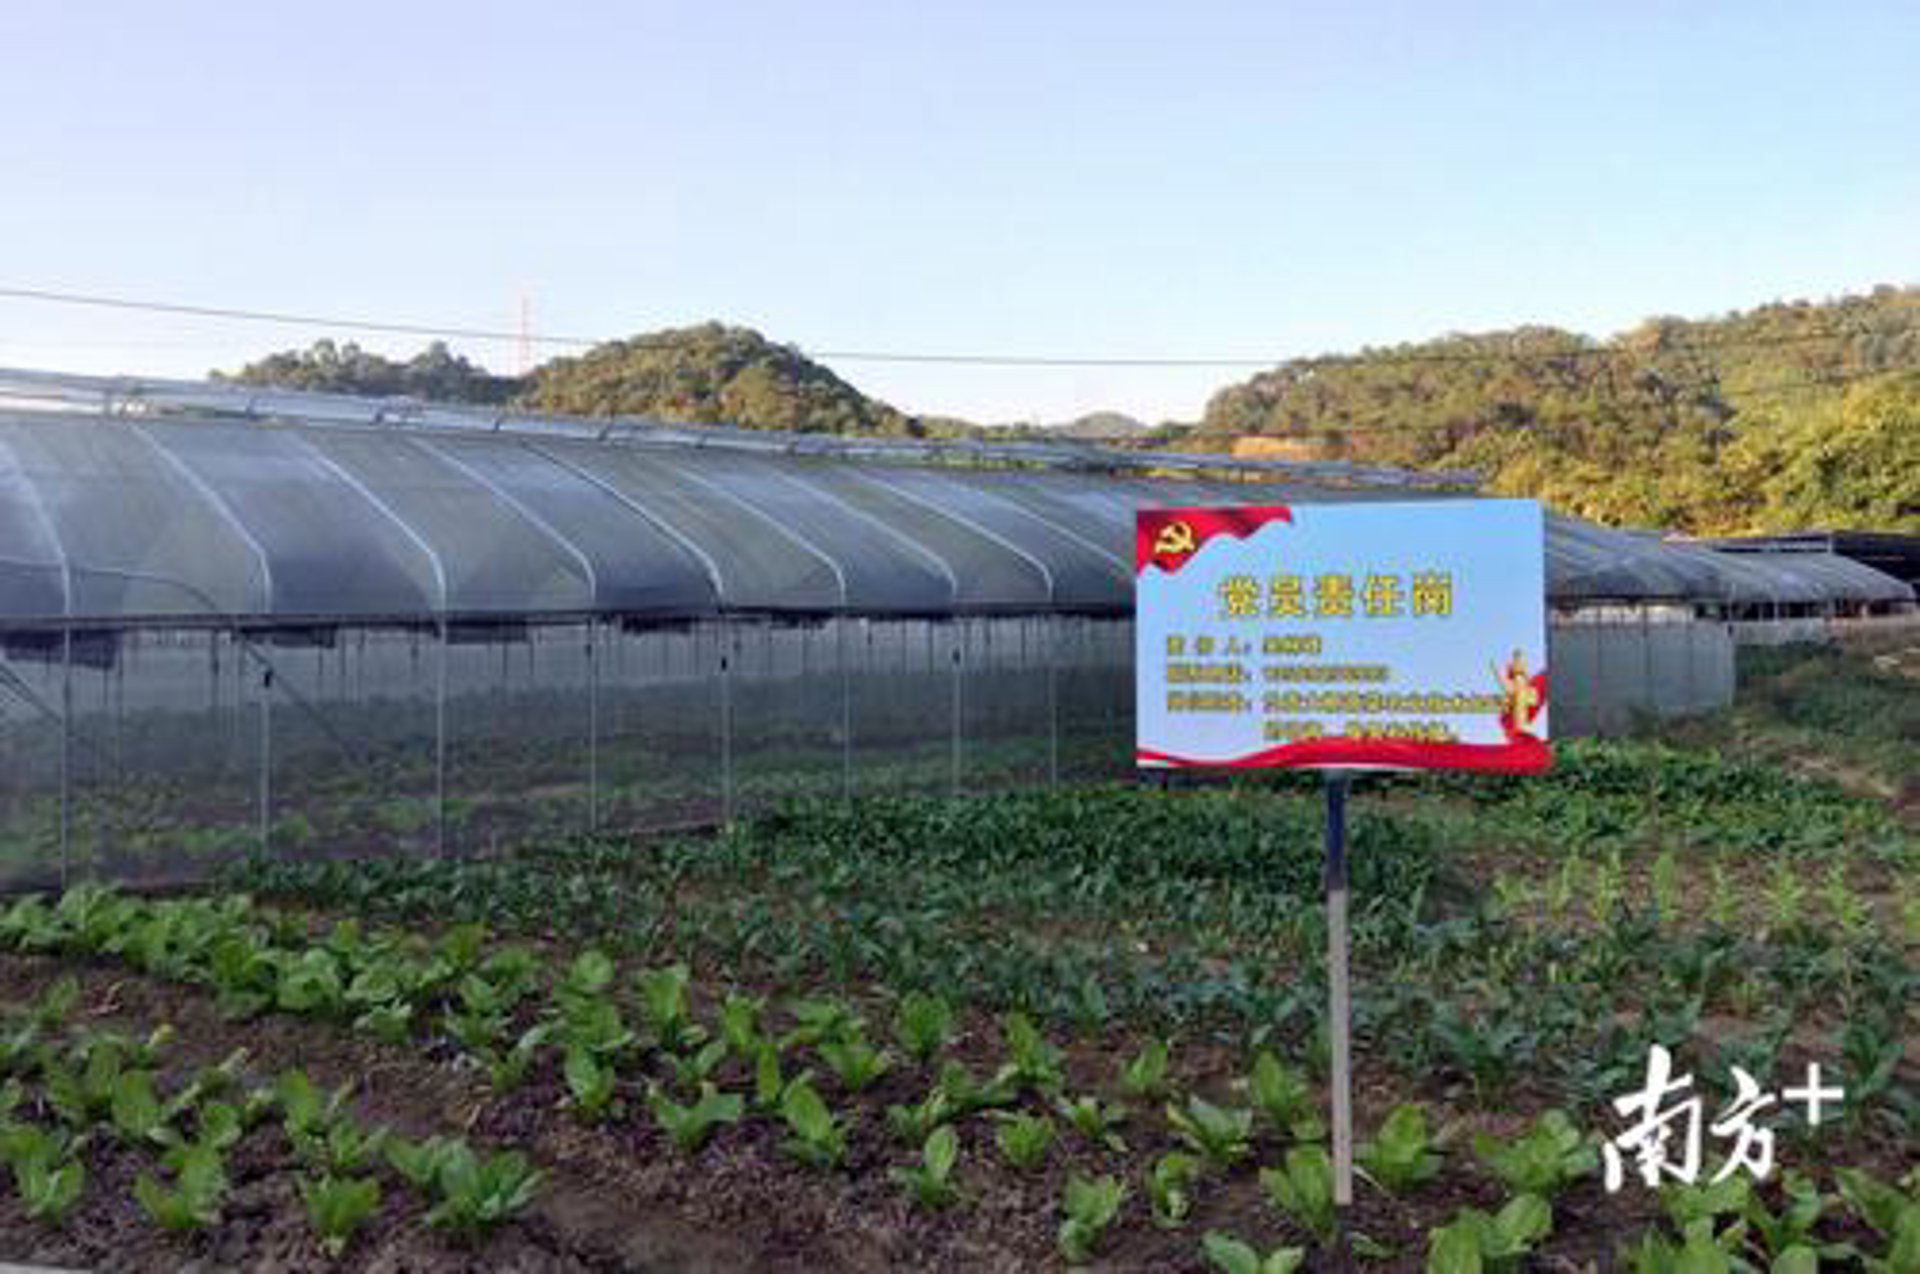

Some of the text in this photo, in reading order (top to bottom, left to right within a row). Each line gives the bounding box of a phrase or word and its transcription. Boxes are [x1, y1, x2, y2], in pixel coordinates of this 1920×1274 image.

[1217, 574, 1453, 617] 党员责任岗
